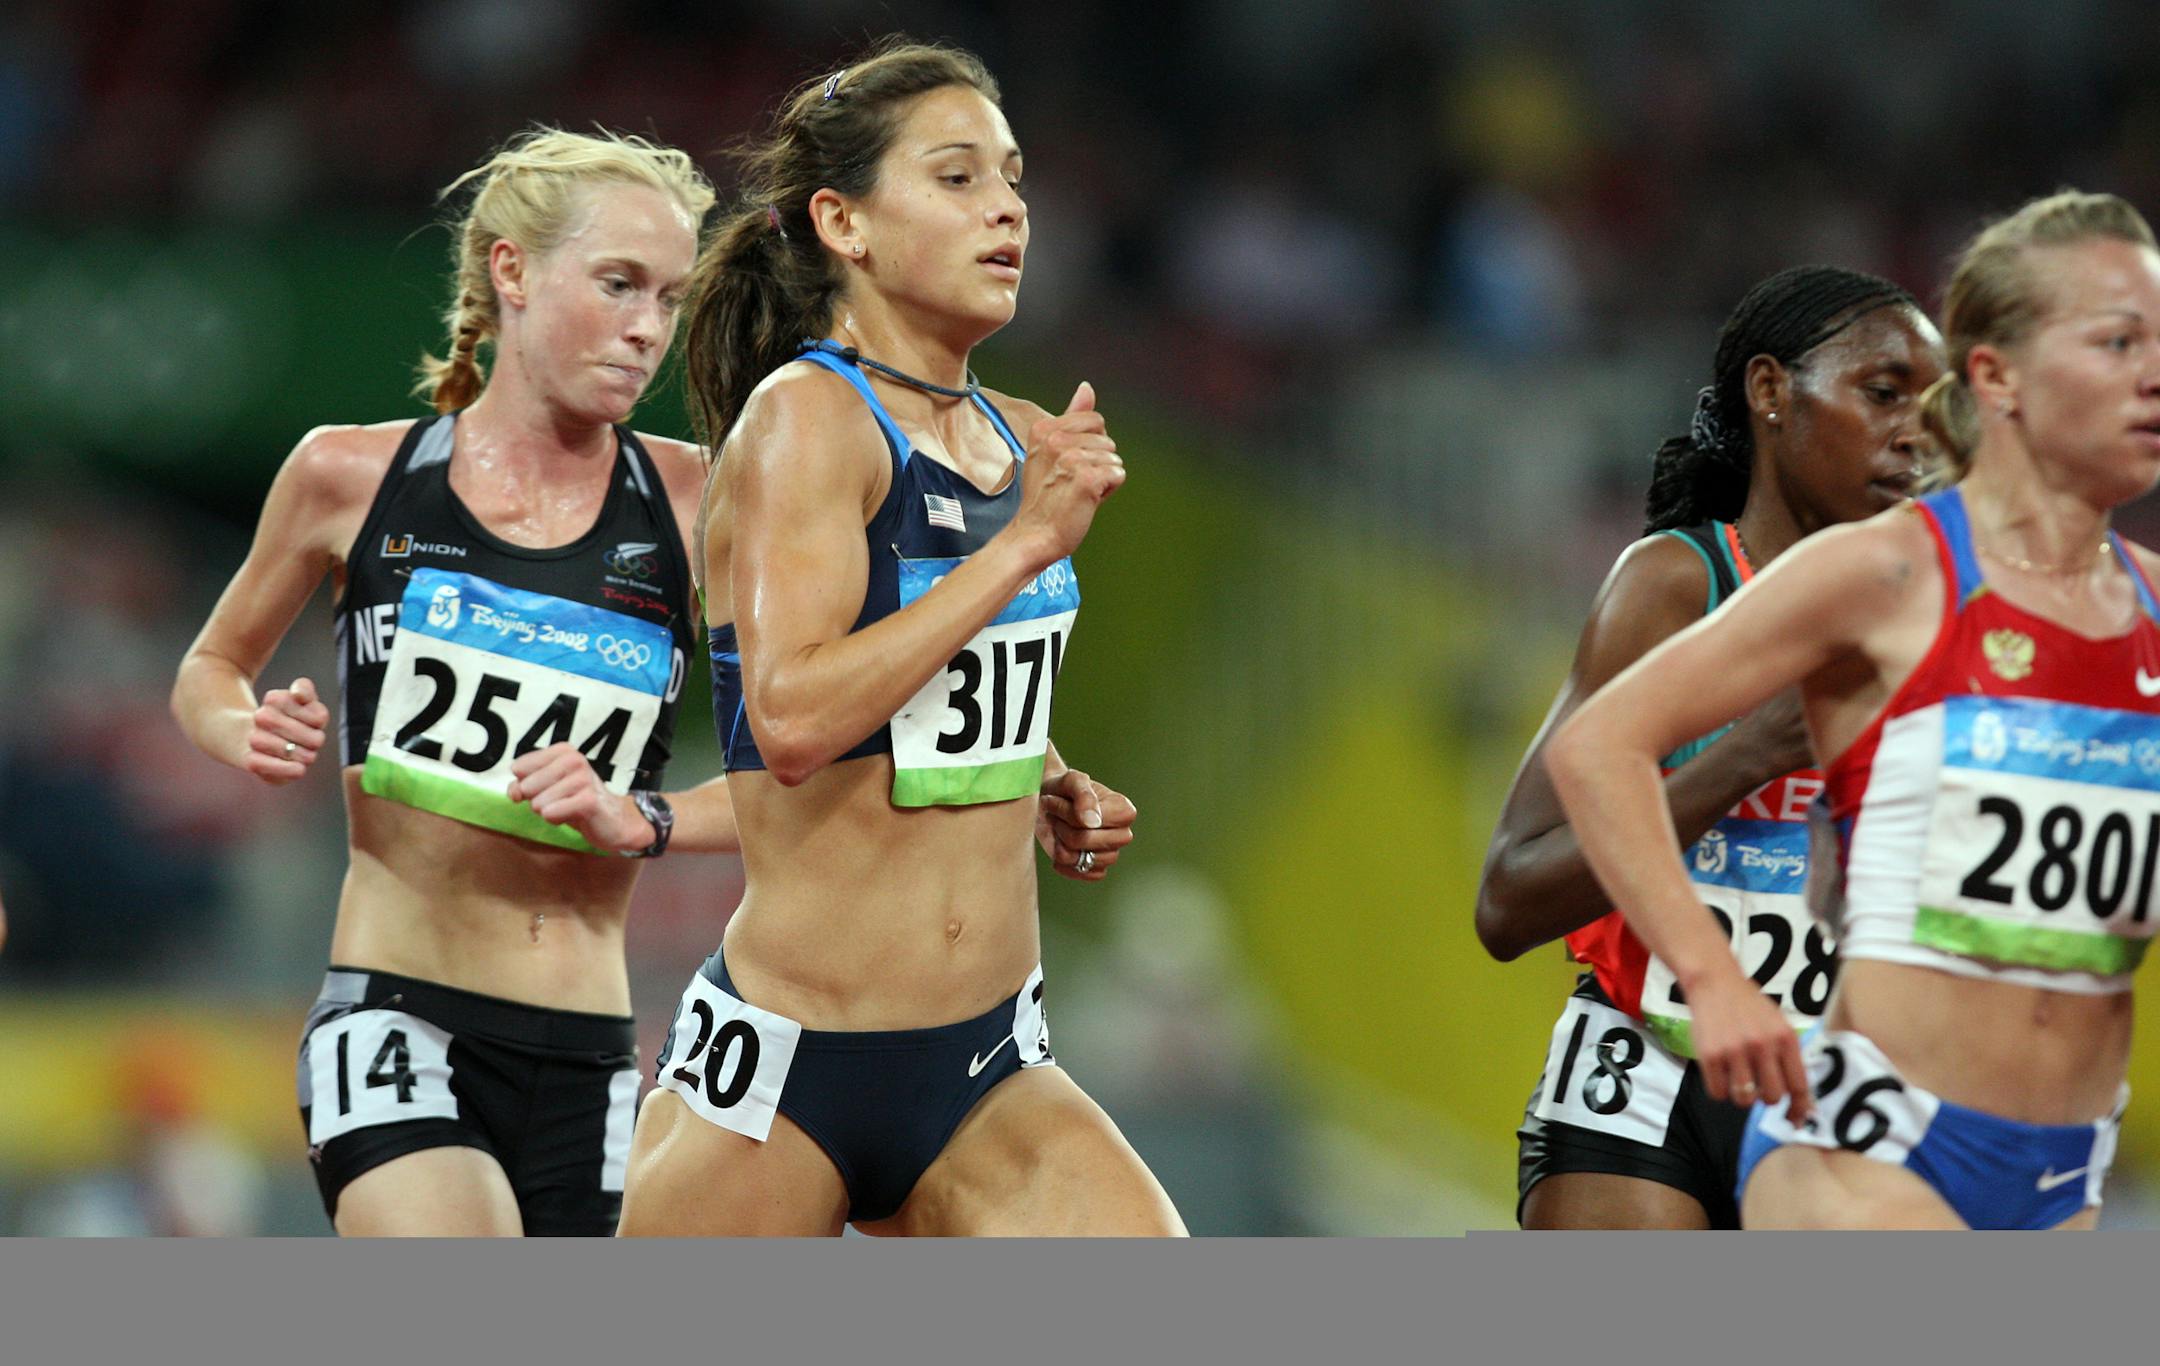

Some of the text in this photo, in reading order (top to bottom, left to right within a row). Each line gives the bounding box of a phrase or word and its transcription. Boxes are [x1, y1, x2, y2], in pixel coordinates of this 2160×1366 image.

[381, 534, 467, 557] UNION
[355, 603, 403, 666] NE
[469, 603, 589, 652] Beijing 2008
[393, 657, 633, 783] 2544
[1735, 845, 1806, 877] Beijing
[1960, 796, 2160, 923] 2801
[337, 1029, 418, 1117] 14
[673, 998, 761, 1109] 20
[1552, 1013, 1645, 1116] 18
